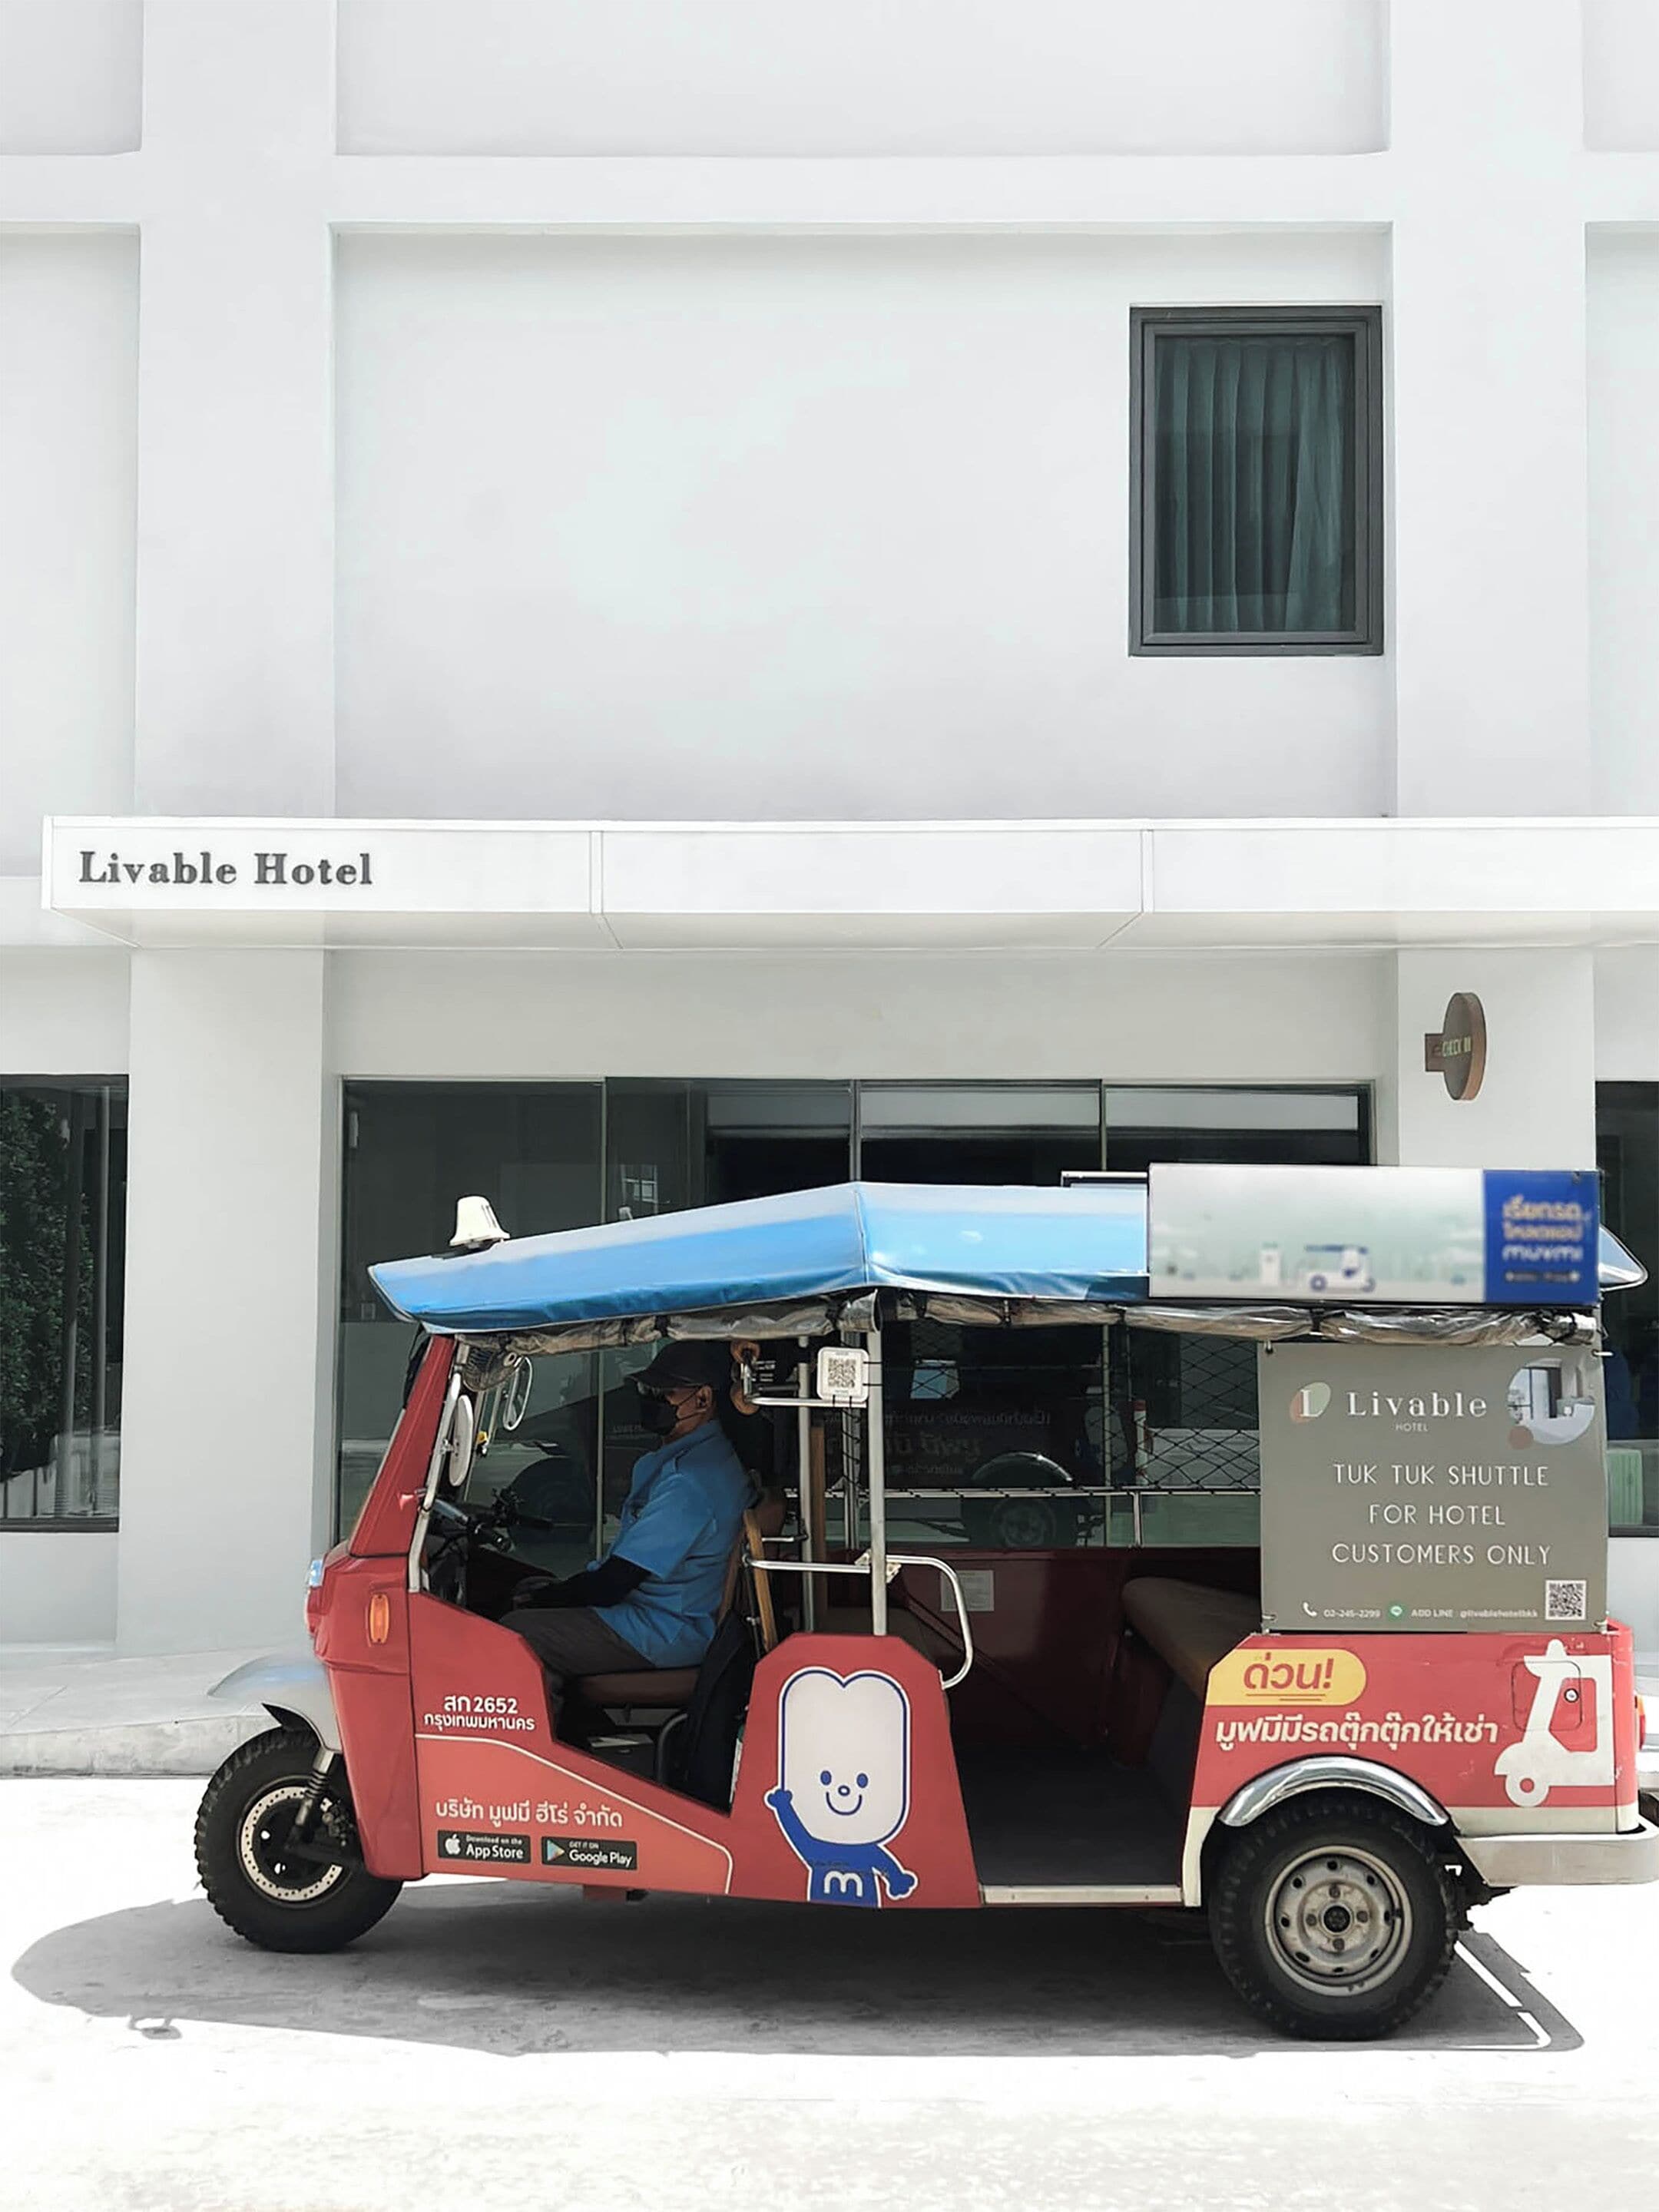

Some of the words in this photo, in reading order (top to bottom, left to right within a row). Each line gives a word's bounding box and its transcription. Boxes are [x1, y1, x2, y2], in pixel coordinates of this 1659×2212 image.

[78, 851, 237, 884] Livable
[254, 853, 373, 885] Hotel
[1347, 1392, 1487, 1418] Livable
[1396, 1422, 1428, 1432] HOTEL
[1333, 1464, 1377, 1484] TUK
[1392, 1465, 1435, 1485] TUK
[1449, 1465, 1548, 1486] SHUTTLE
[1369, 1504, 1416, 1524] FOR
[1429, 1505, 1505, 1525] HOTEL
[1332, 1543, 1474, 1564] CUSTOMERS
[1487, 1545, 1550, 1565] ONLY
[1411, 1609, 1432, 1618] ADD
[1433, 1609, 1453, 1618] LINE
[1243, 1652, 1334, 1690] ด่วน!
[444, 1695, 471, 1712] สก
[473, 1697, 518, 1714] 2652
[424, 1714, 535, 1731] กรุงเทพมหานคร
[1216, 1712, 1498, 1750] มูฟมีมีรถตุ๊กตุ๊กให้เช่า
[435, 1797, 483, 1819] บริษัท
[489, 1800, 530, 1827] มูฟมี
[536, 1801, 569, 1824] ฮีโร่
[574, 1803, 622, 1827] จำกัด
[466, 1834, 499, 1843] Download
[511, 1836, 522, 1845] the
[466, 1844, 493, 1859] App
[494, 1846, 524, 1859] Store
[569, 1849, 608, 1865] Google
[610, 1852, 632, 1867] Play
